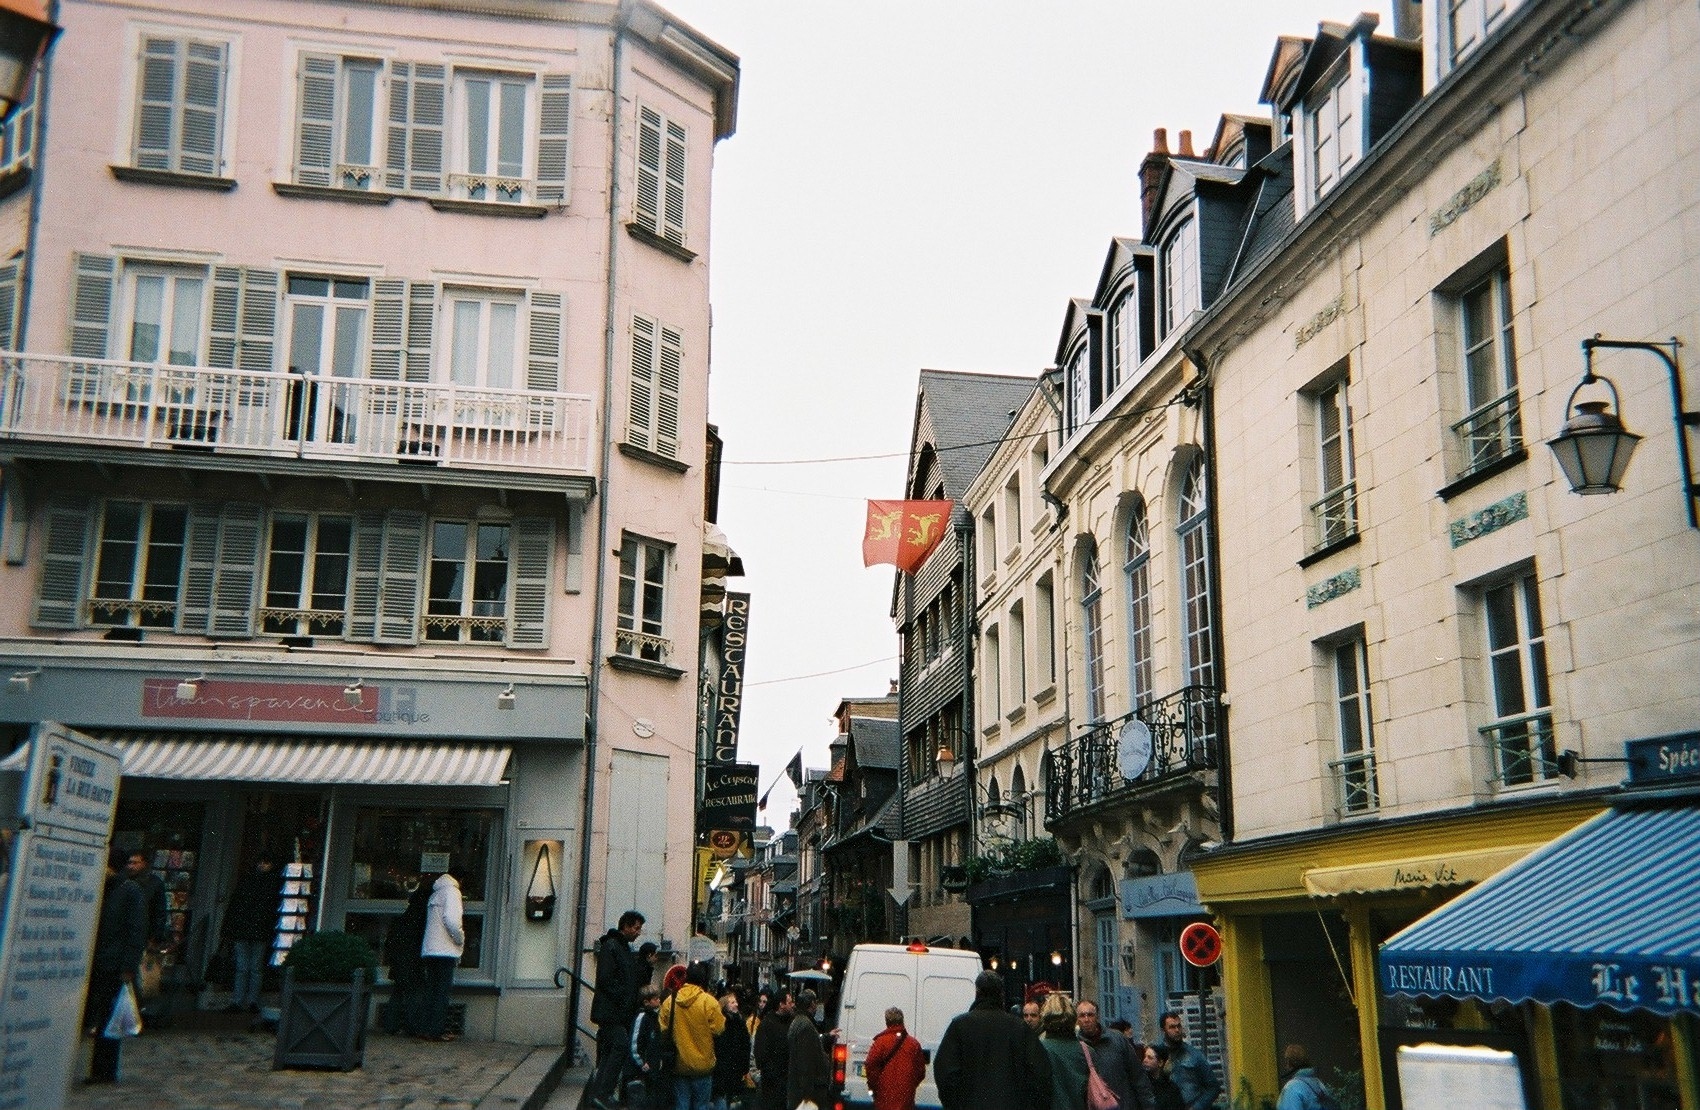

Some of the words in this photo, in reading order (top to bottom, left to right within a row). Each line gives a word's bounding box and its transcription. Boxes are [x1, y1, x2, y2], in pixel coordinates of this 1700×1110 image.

[715, 600, 748, 762] RESTAURANT
[1388, 964, 1493, 994] RESTAURANT
[1591, 963, 1640, 1001] Le
